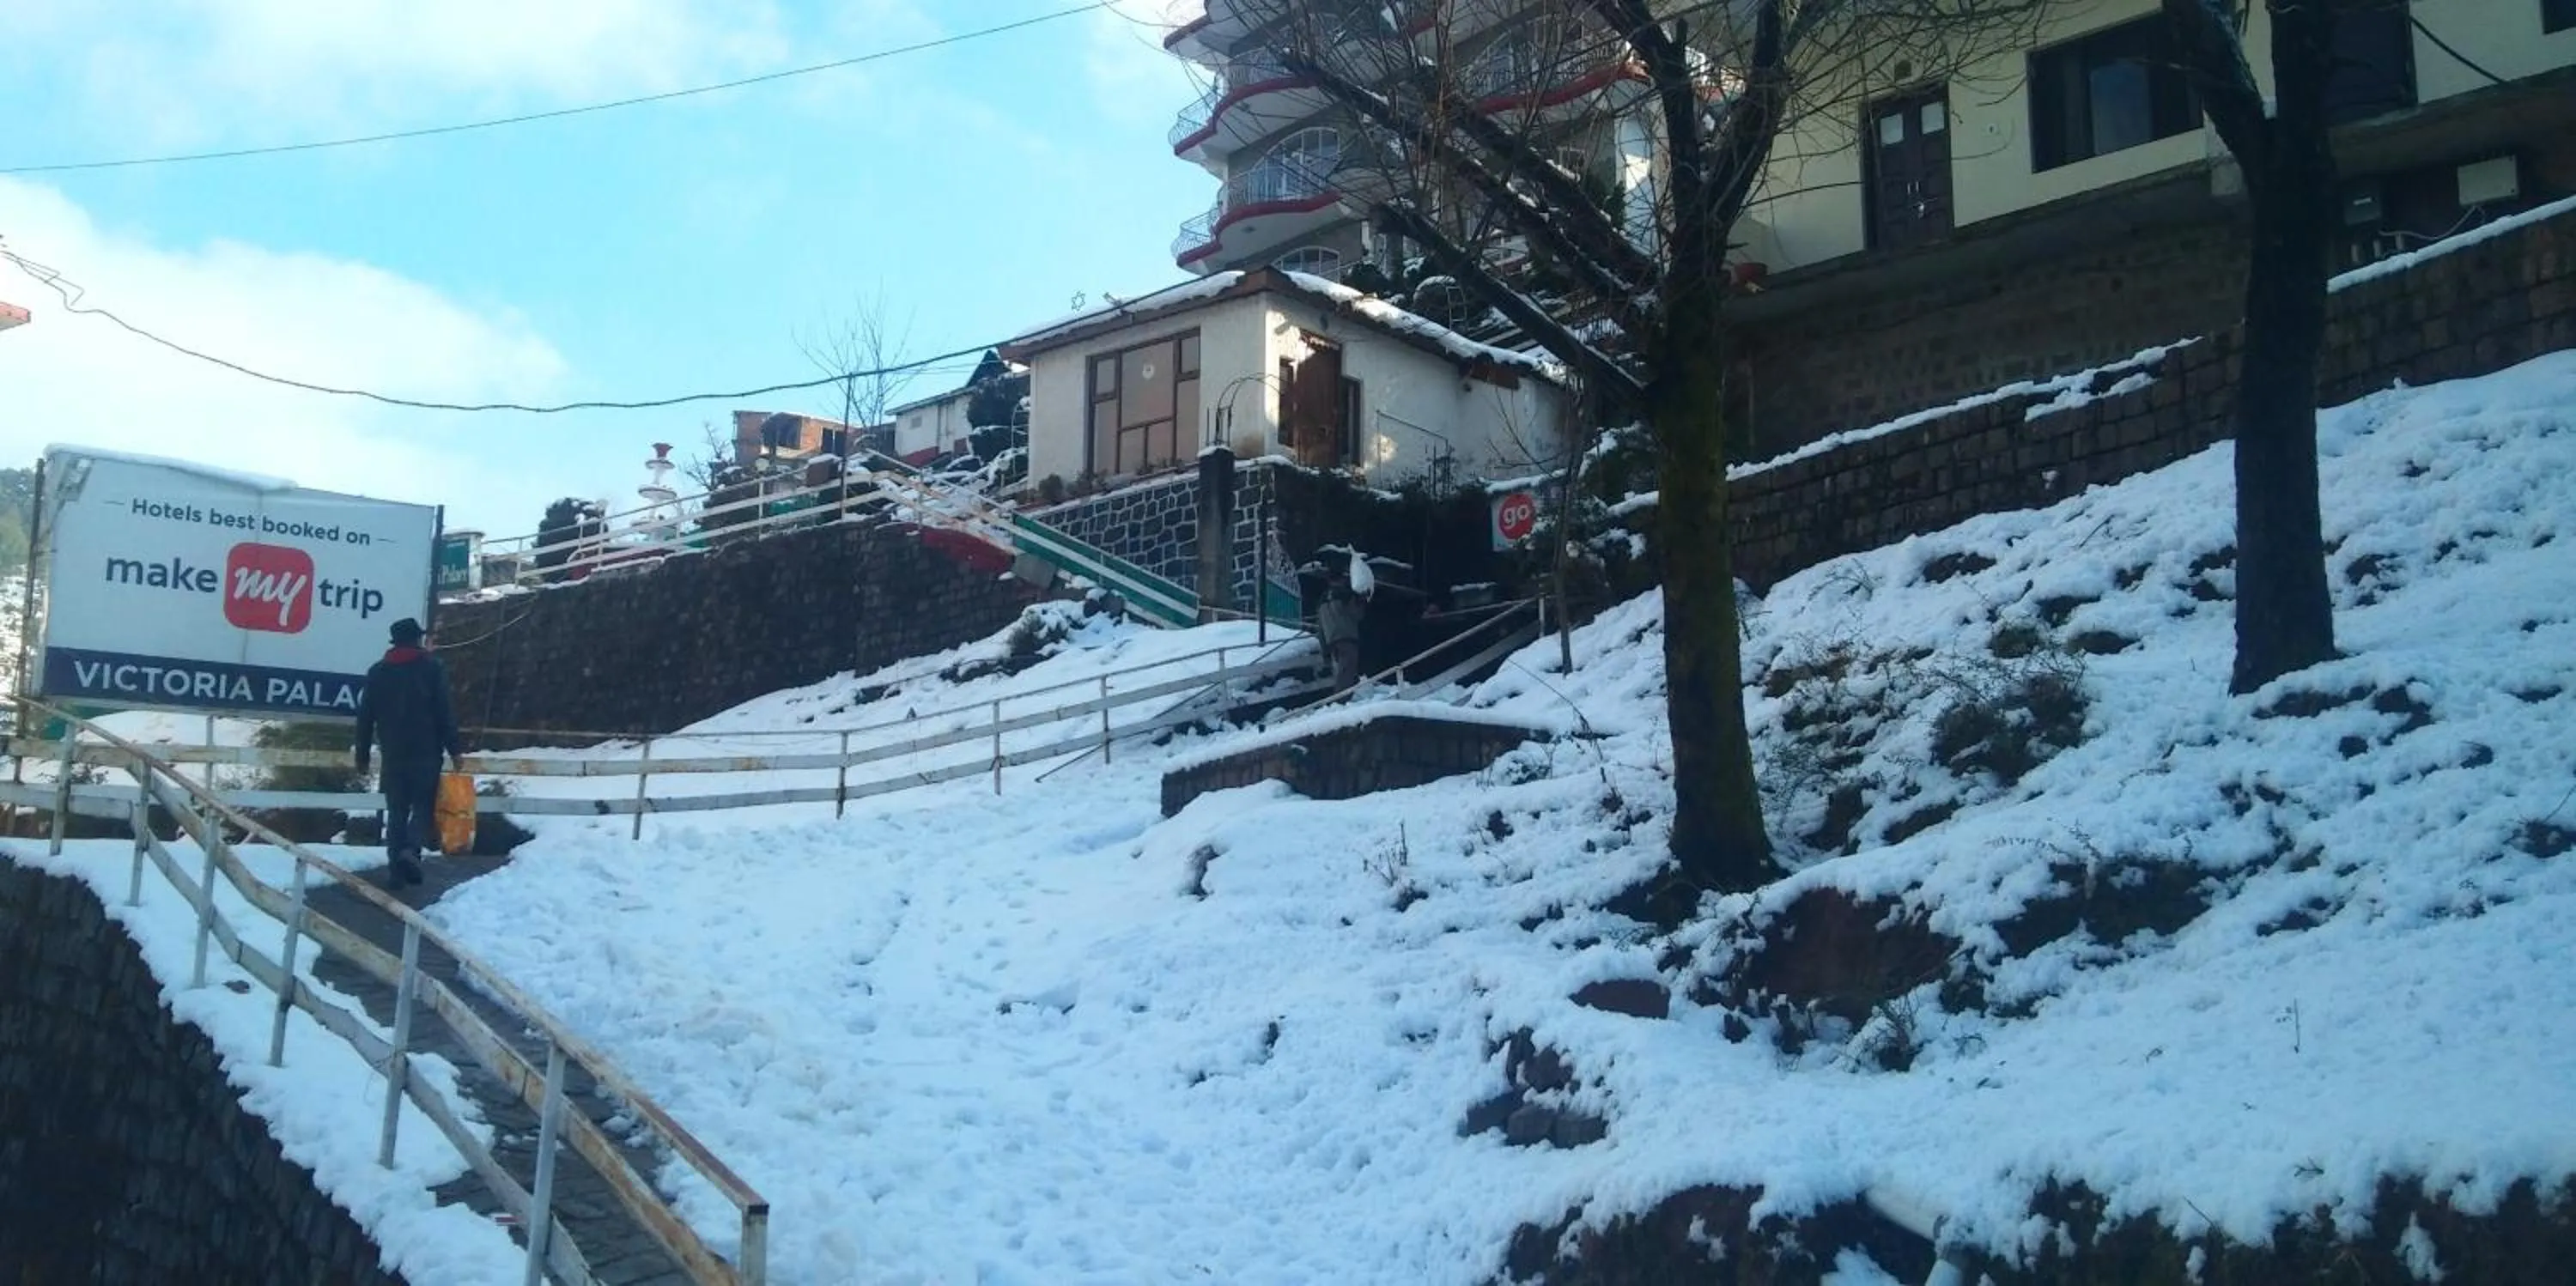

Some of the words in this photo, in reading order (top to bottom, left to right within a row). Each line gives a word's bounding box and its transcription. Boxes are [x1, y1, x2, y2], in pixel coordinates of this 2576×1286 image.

[131, 498, 203, 523] Hotels
[209, 508, 256, 530] best
[262, 516, 340, 542] booked
[346, 531, 371, 546] on
[1504, 504, 1529, 529] go
[105, 556, 218, 593] make
[234, 566, 307, 627] my
[318, 578, 384, 619] trip
[74, 660, 254, 701] VICTORIA
